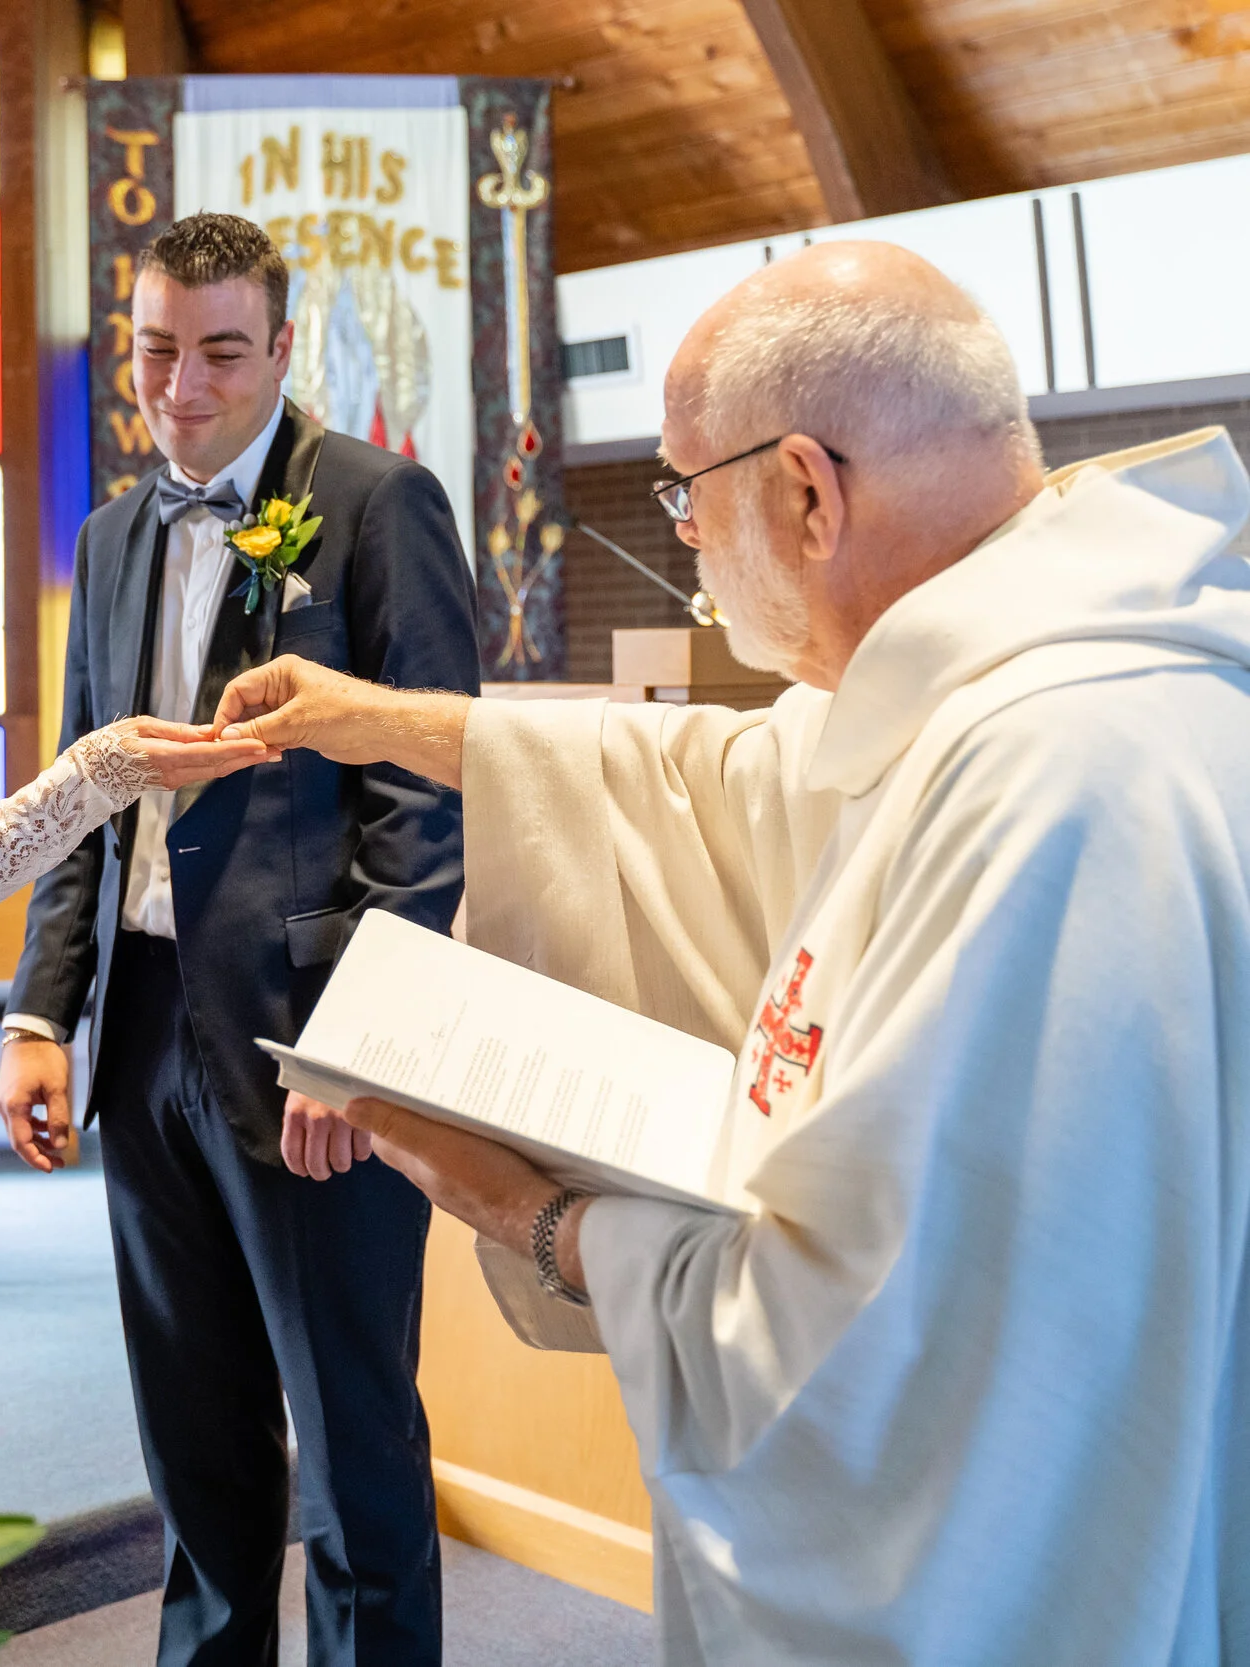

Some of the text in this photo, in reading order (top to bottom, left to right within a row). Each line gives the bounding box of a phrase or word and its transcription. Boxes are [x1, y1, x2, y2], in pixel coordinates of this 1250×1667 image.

[105, 125, 160, 227] TO
[238, 124, 407, 206] IN HIS
[264, 209, 463, 290] ESENCE
